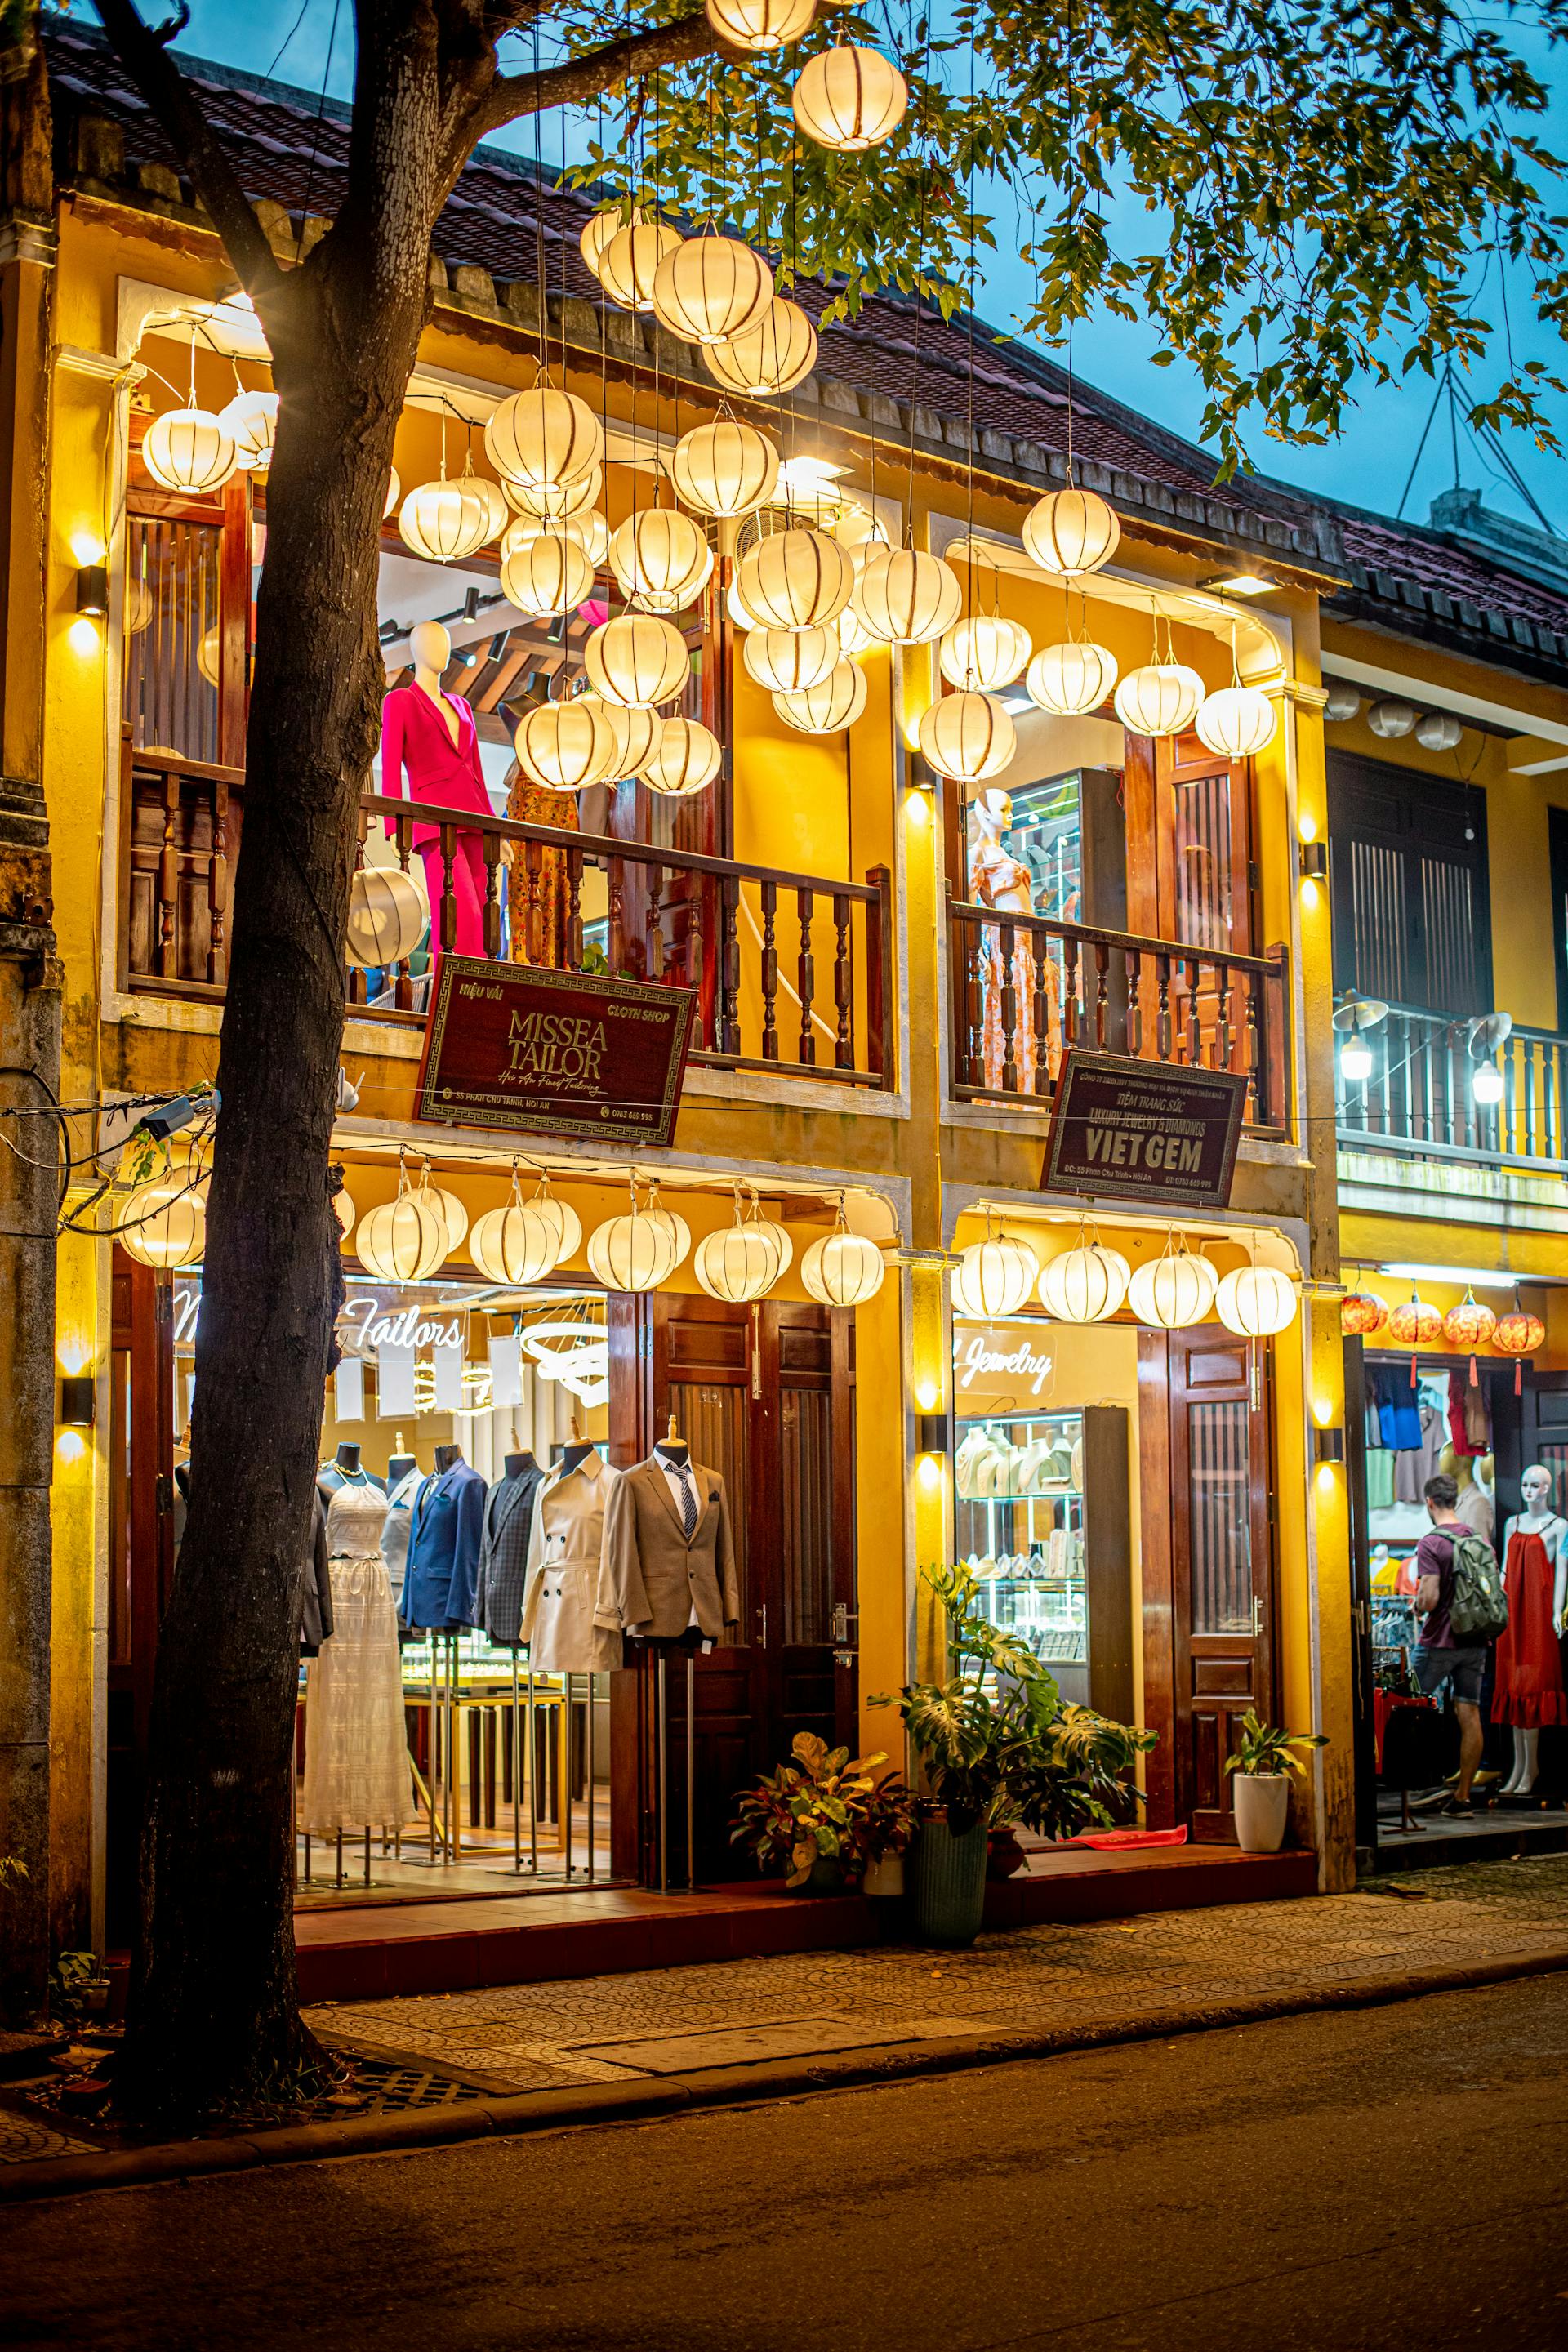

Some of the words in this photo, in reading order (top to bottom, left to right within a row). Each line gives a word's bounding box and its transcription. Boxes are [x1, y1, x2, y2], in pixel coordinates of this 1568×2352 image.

[459, 982, 485, 1000] HIỆU
[486, 985, 504, 1000] VẢI
[607, 1004, 642, 1020] CLOTH
[642, 1009, 670, 1023] SHOP
[508, 1009, 608, 1051] MISSEA
[508, 1039, 601, 1080] TAILOR
[539, 1101, 550, 1110] AN
[1139, 1095, 1167, 1111] TRANG
[1089, 1107, 1122, 1126] LUXURY
[1122, 1111, 1157, 1130] JEWELRY
[1165, 1119, 1206, 1138] DIAMONDS
[345, 1298, 465, 1348] Tailors
[960, 1337, 1052, 1395] Jewelry
